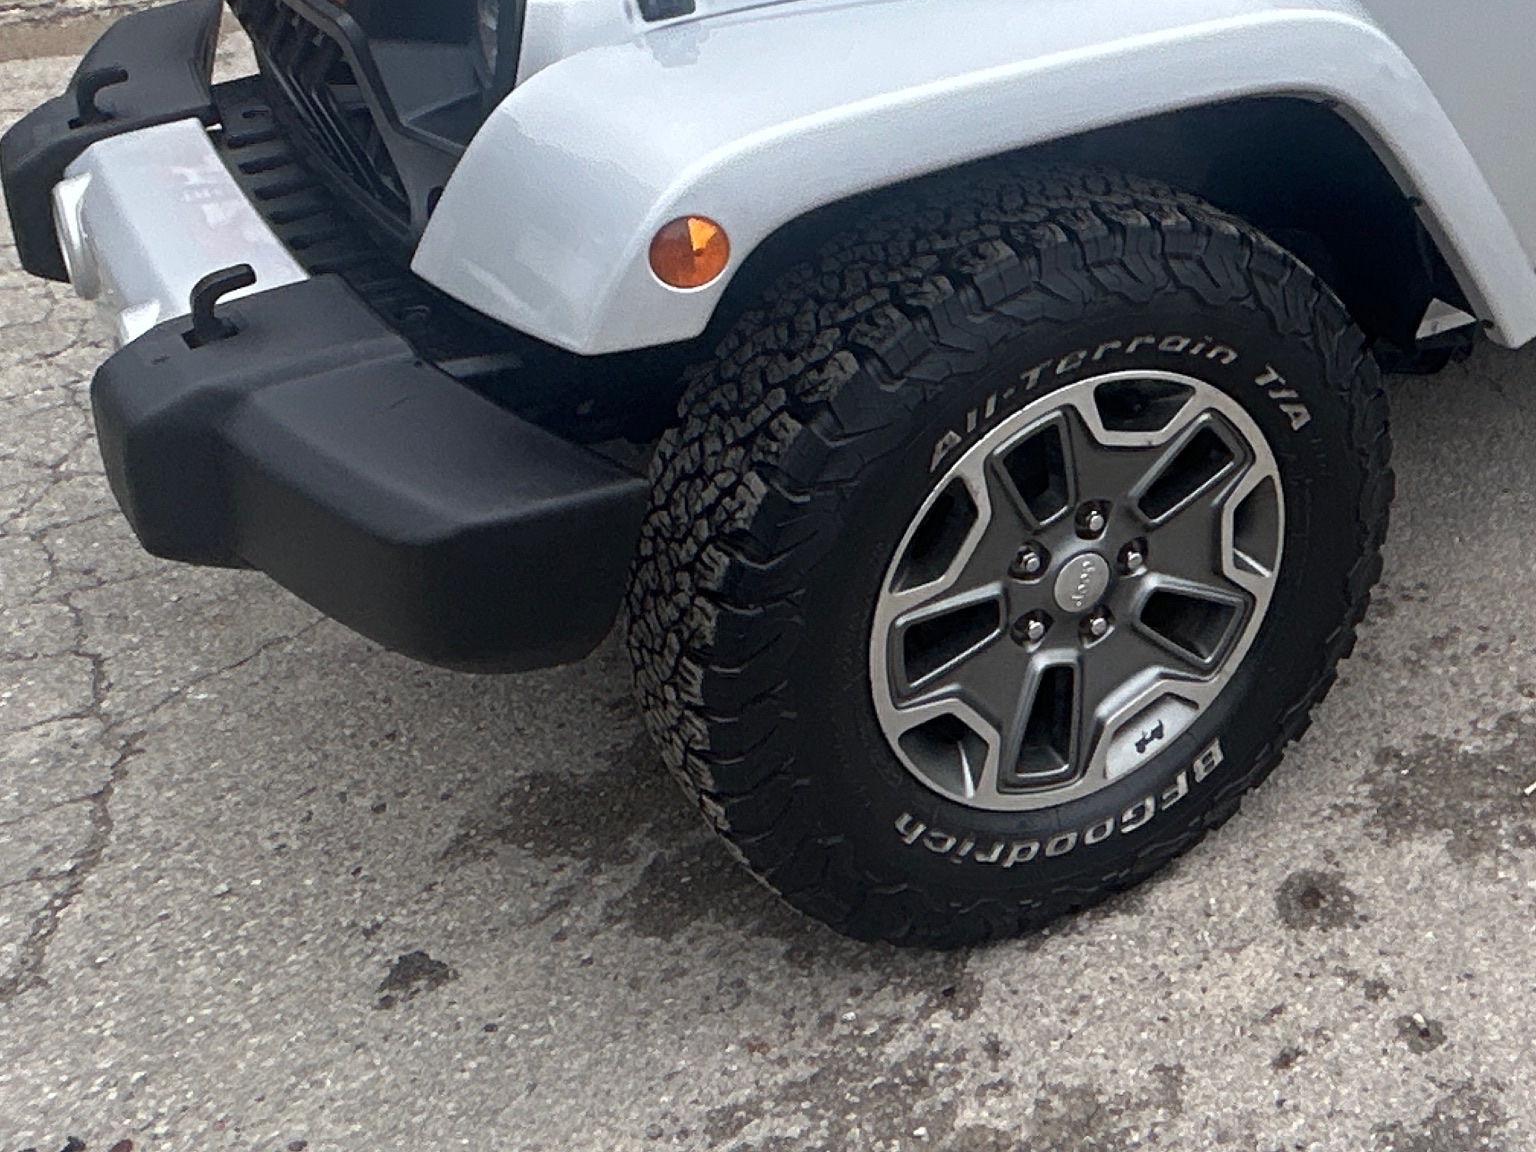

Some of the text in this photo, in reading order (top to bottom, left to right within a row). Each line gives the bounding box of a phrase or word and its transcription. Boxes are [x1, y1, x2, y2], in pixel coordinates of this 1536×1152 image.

[930, 333, 1312, 473] All-Terrain T/A
[893, 737, 1226, 869] BFGoodrich
